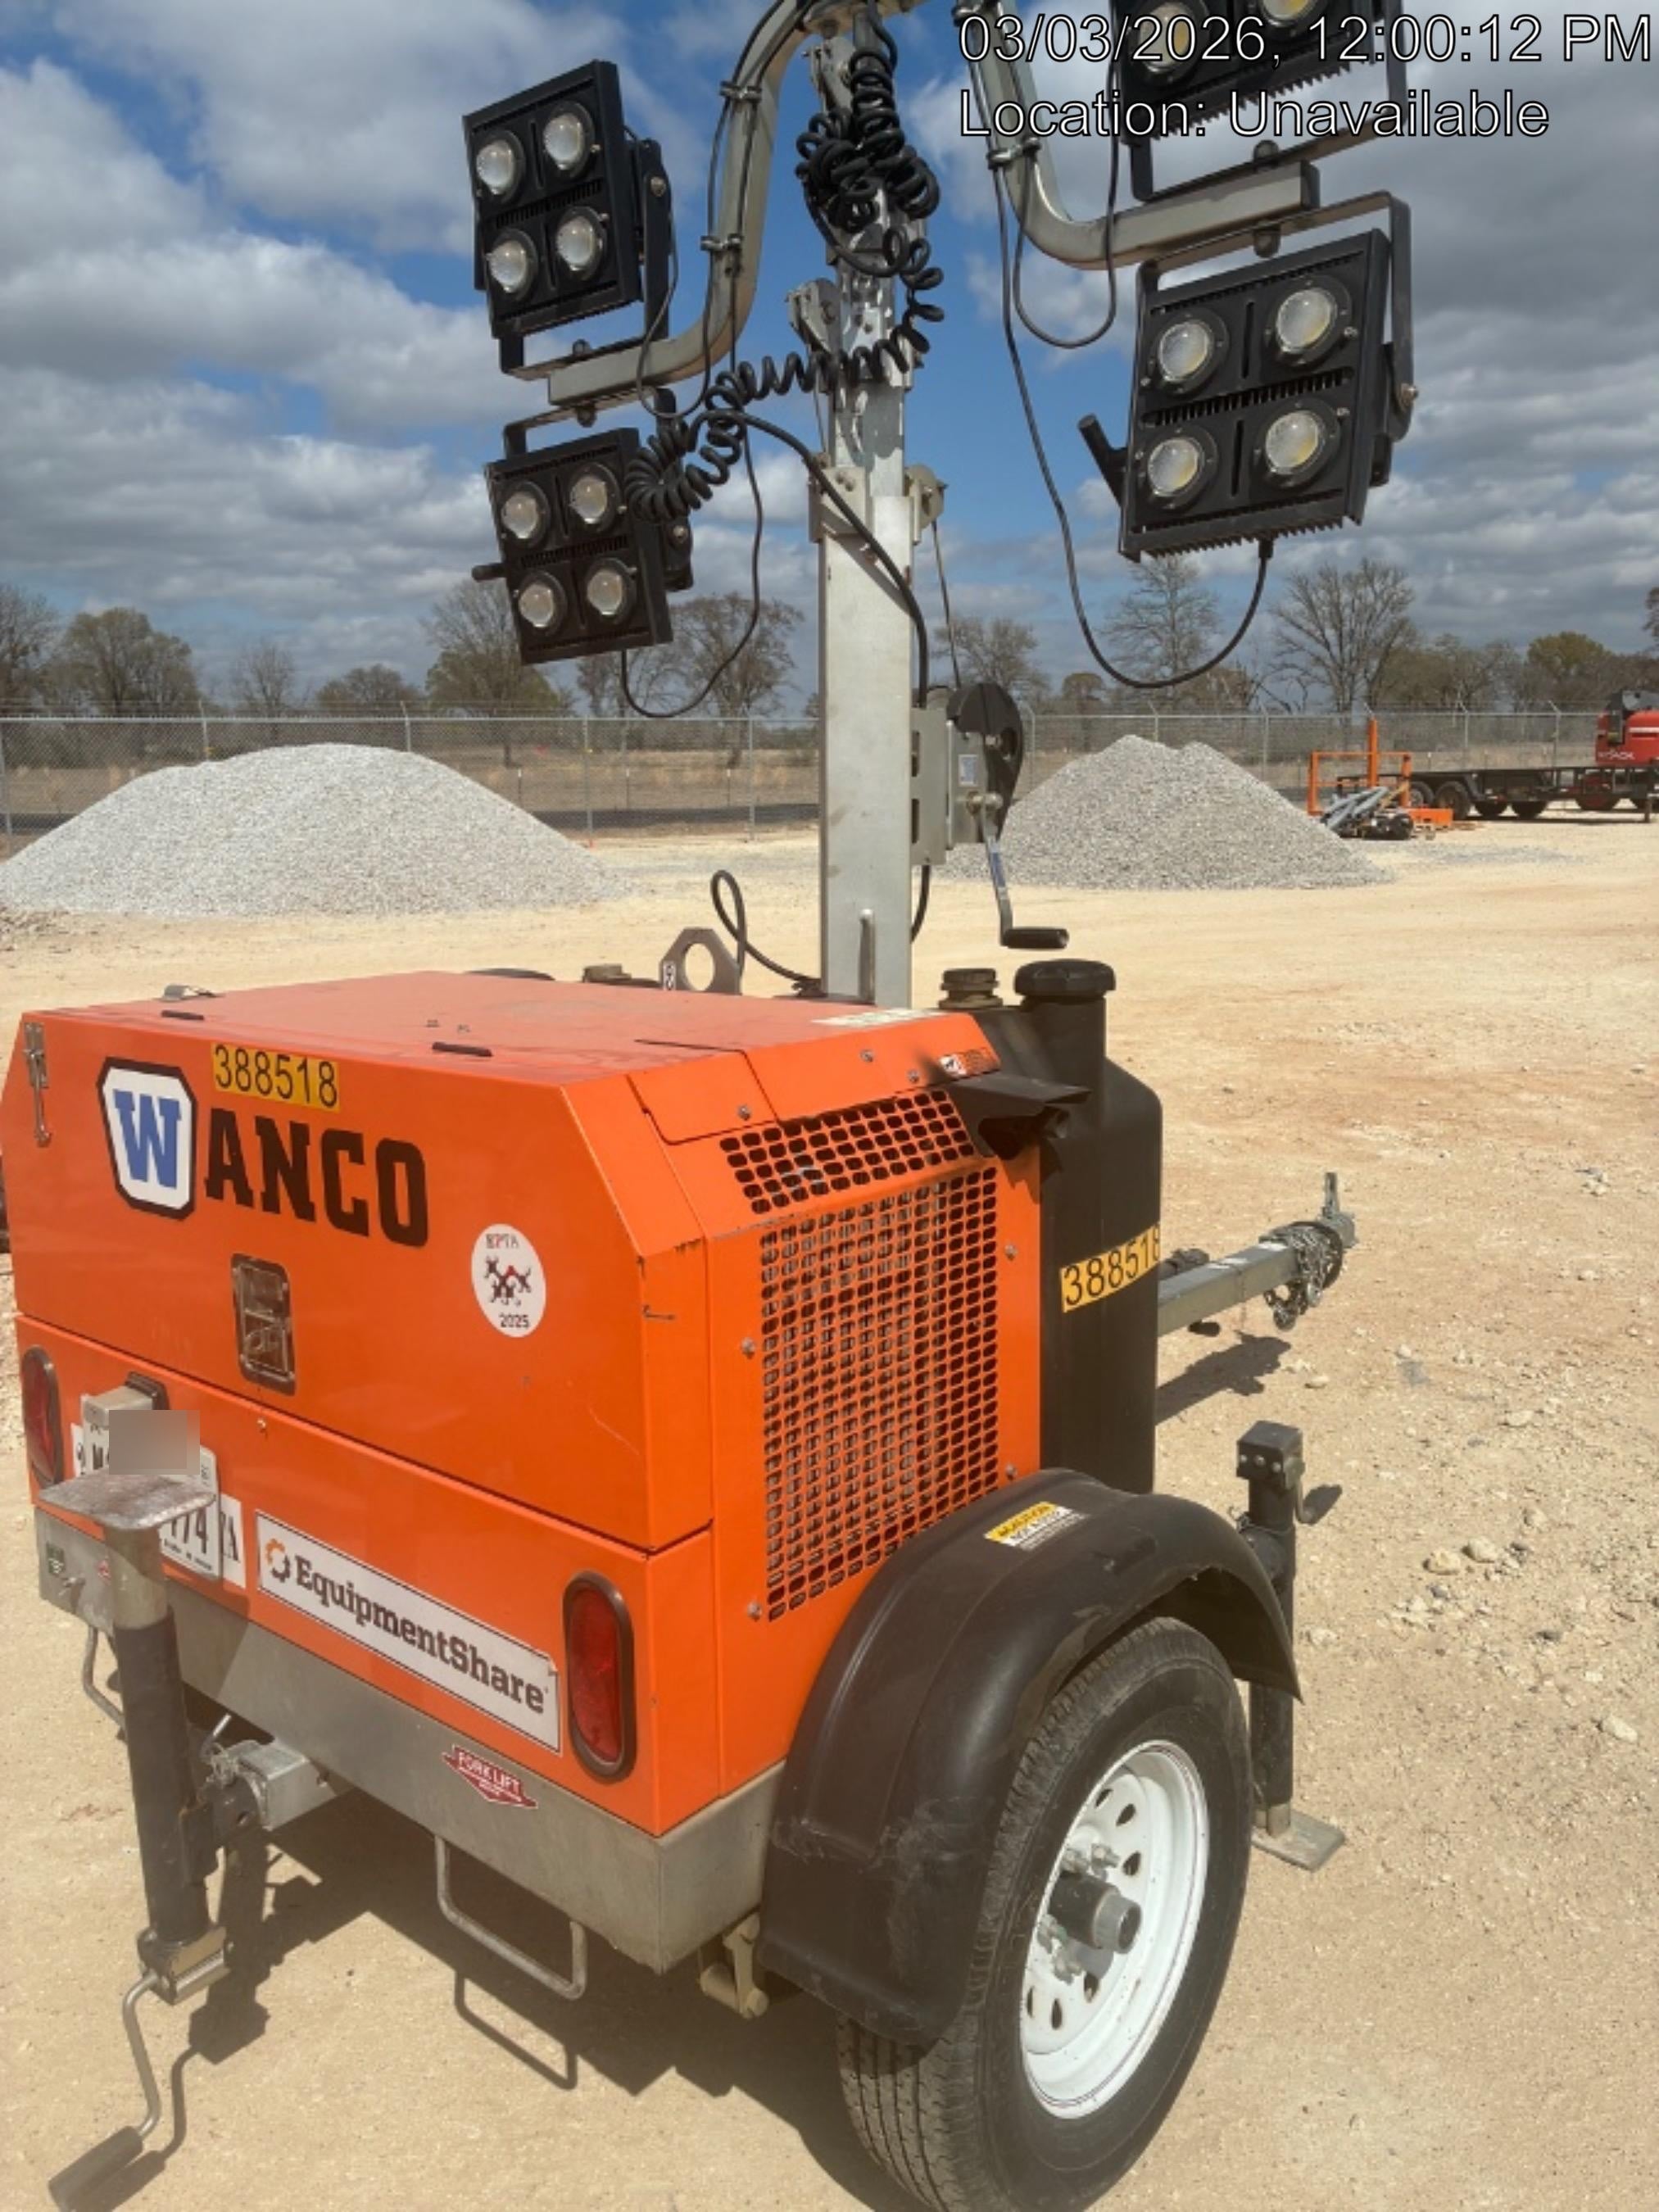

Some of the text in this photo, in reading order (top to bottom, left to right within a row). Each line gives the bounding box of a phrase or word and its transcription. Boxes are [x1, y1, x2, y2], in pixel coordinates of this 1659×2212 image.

[215, 1044, 338, 1108] 388518
[1064, 1222, 1160, 1305] 388518
[499, 1313, 529, 1329] 2025
[295, 1555, 545, 1714] EquipmentShare
